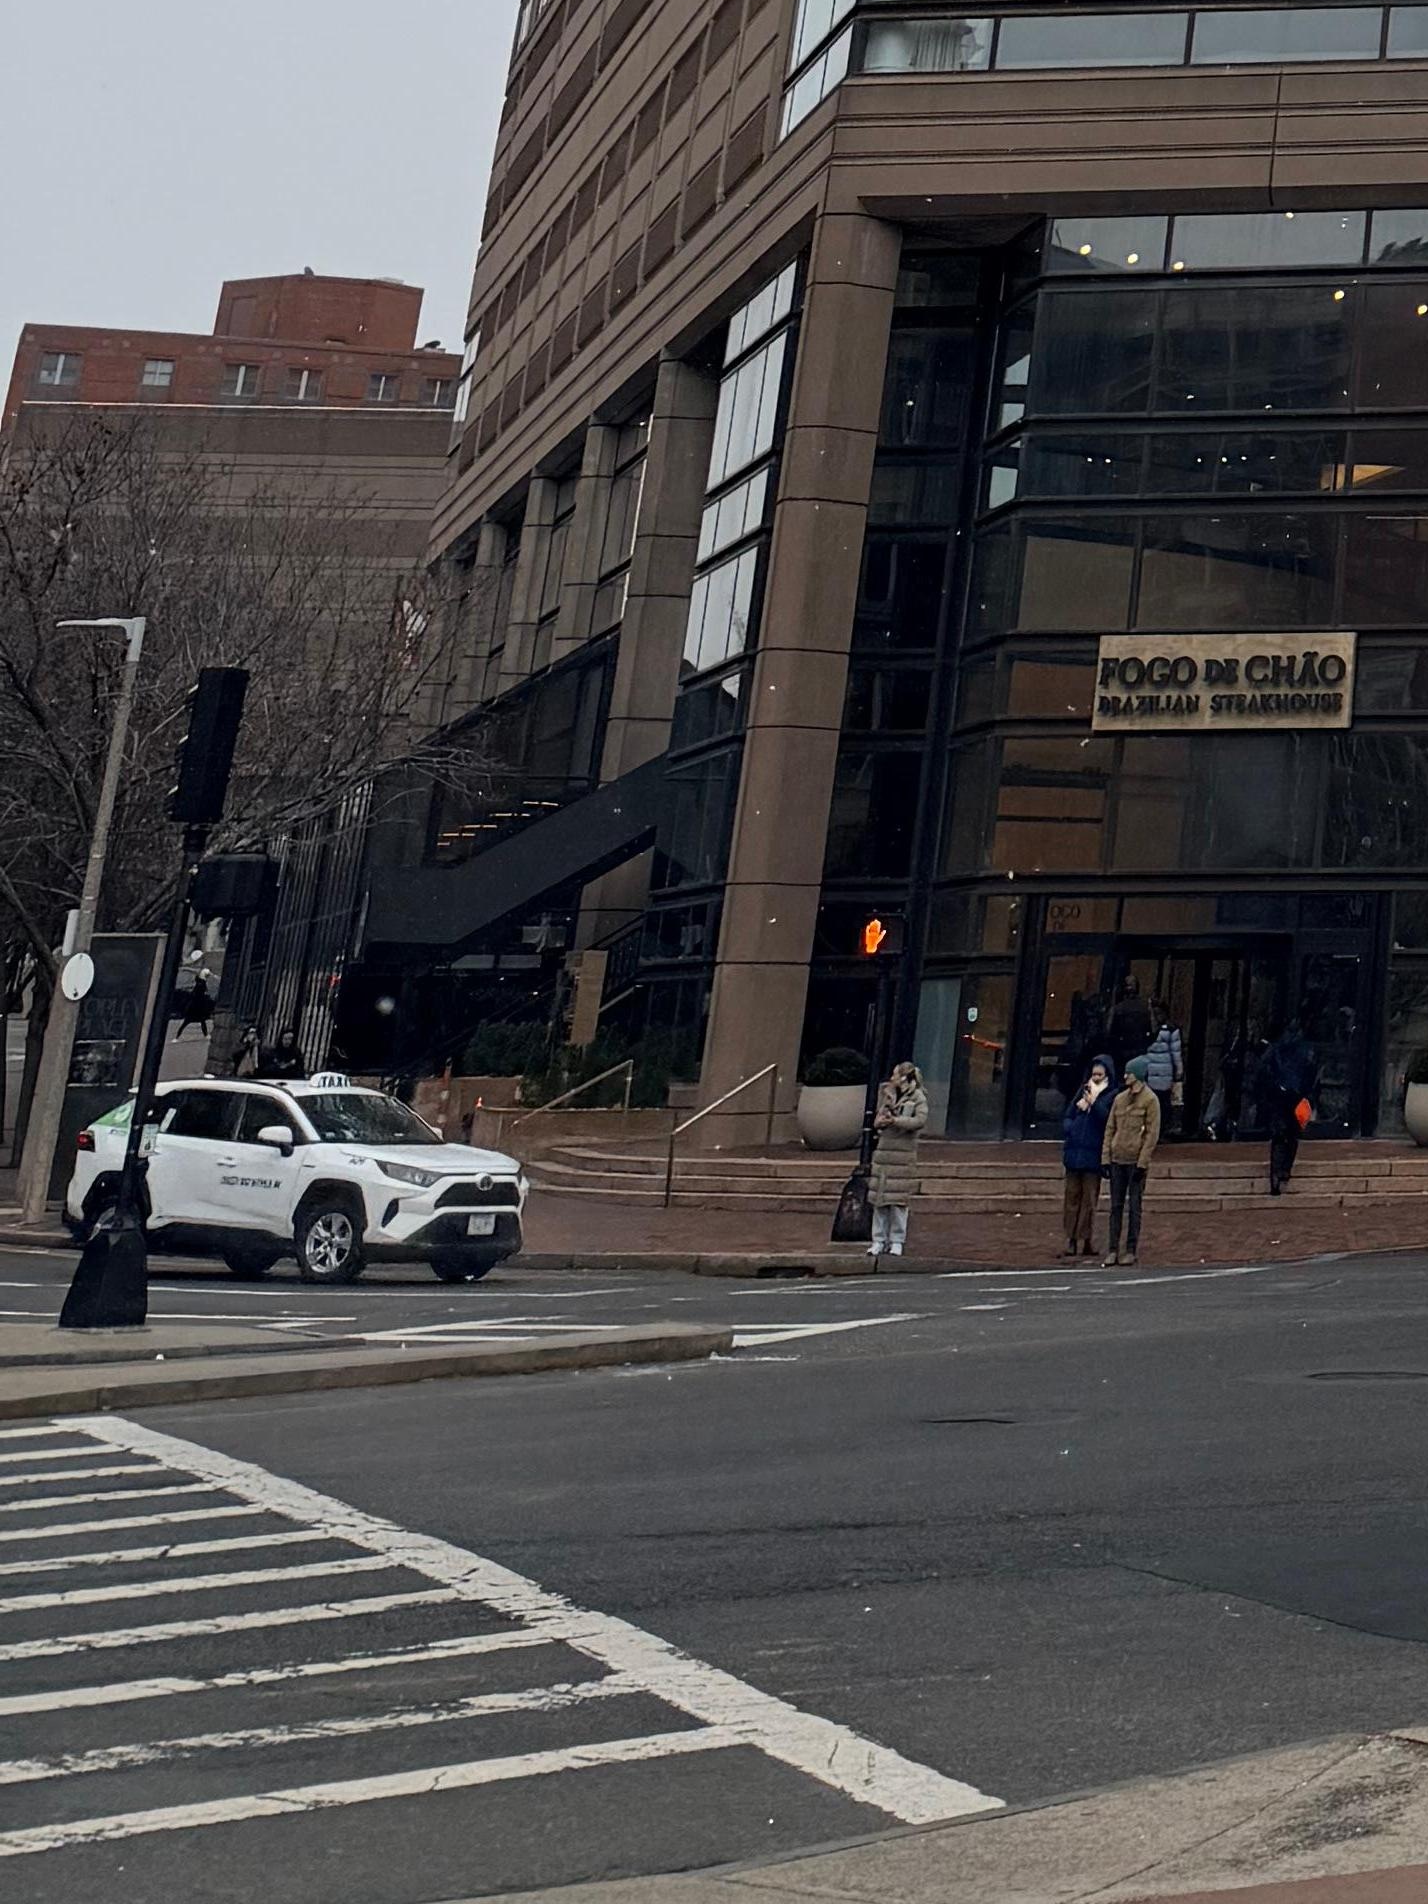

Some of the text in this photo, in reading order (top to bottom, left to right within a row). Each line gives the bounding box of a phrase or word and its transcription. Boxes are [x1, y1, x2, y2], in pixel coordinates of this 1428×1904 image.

[1098, 651, 1347, 689] FOGO DE CHÃO
[1097, 693, 1344, 715] BRAZILIAN STEAKHOUSE
